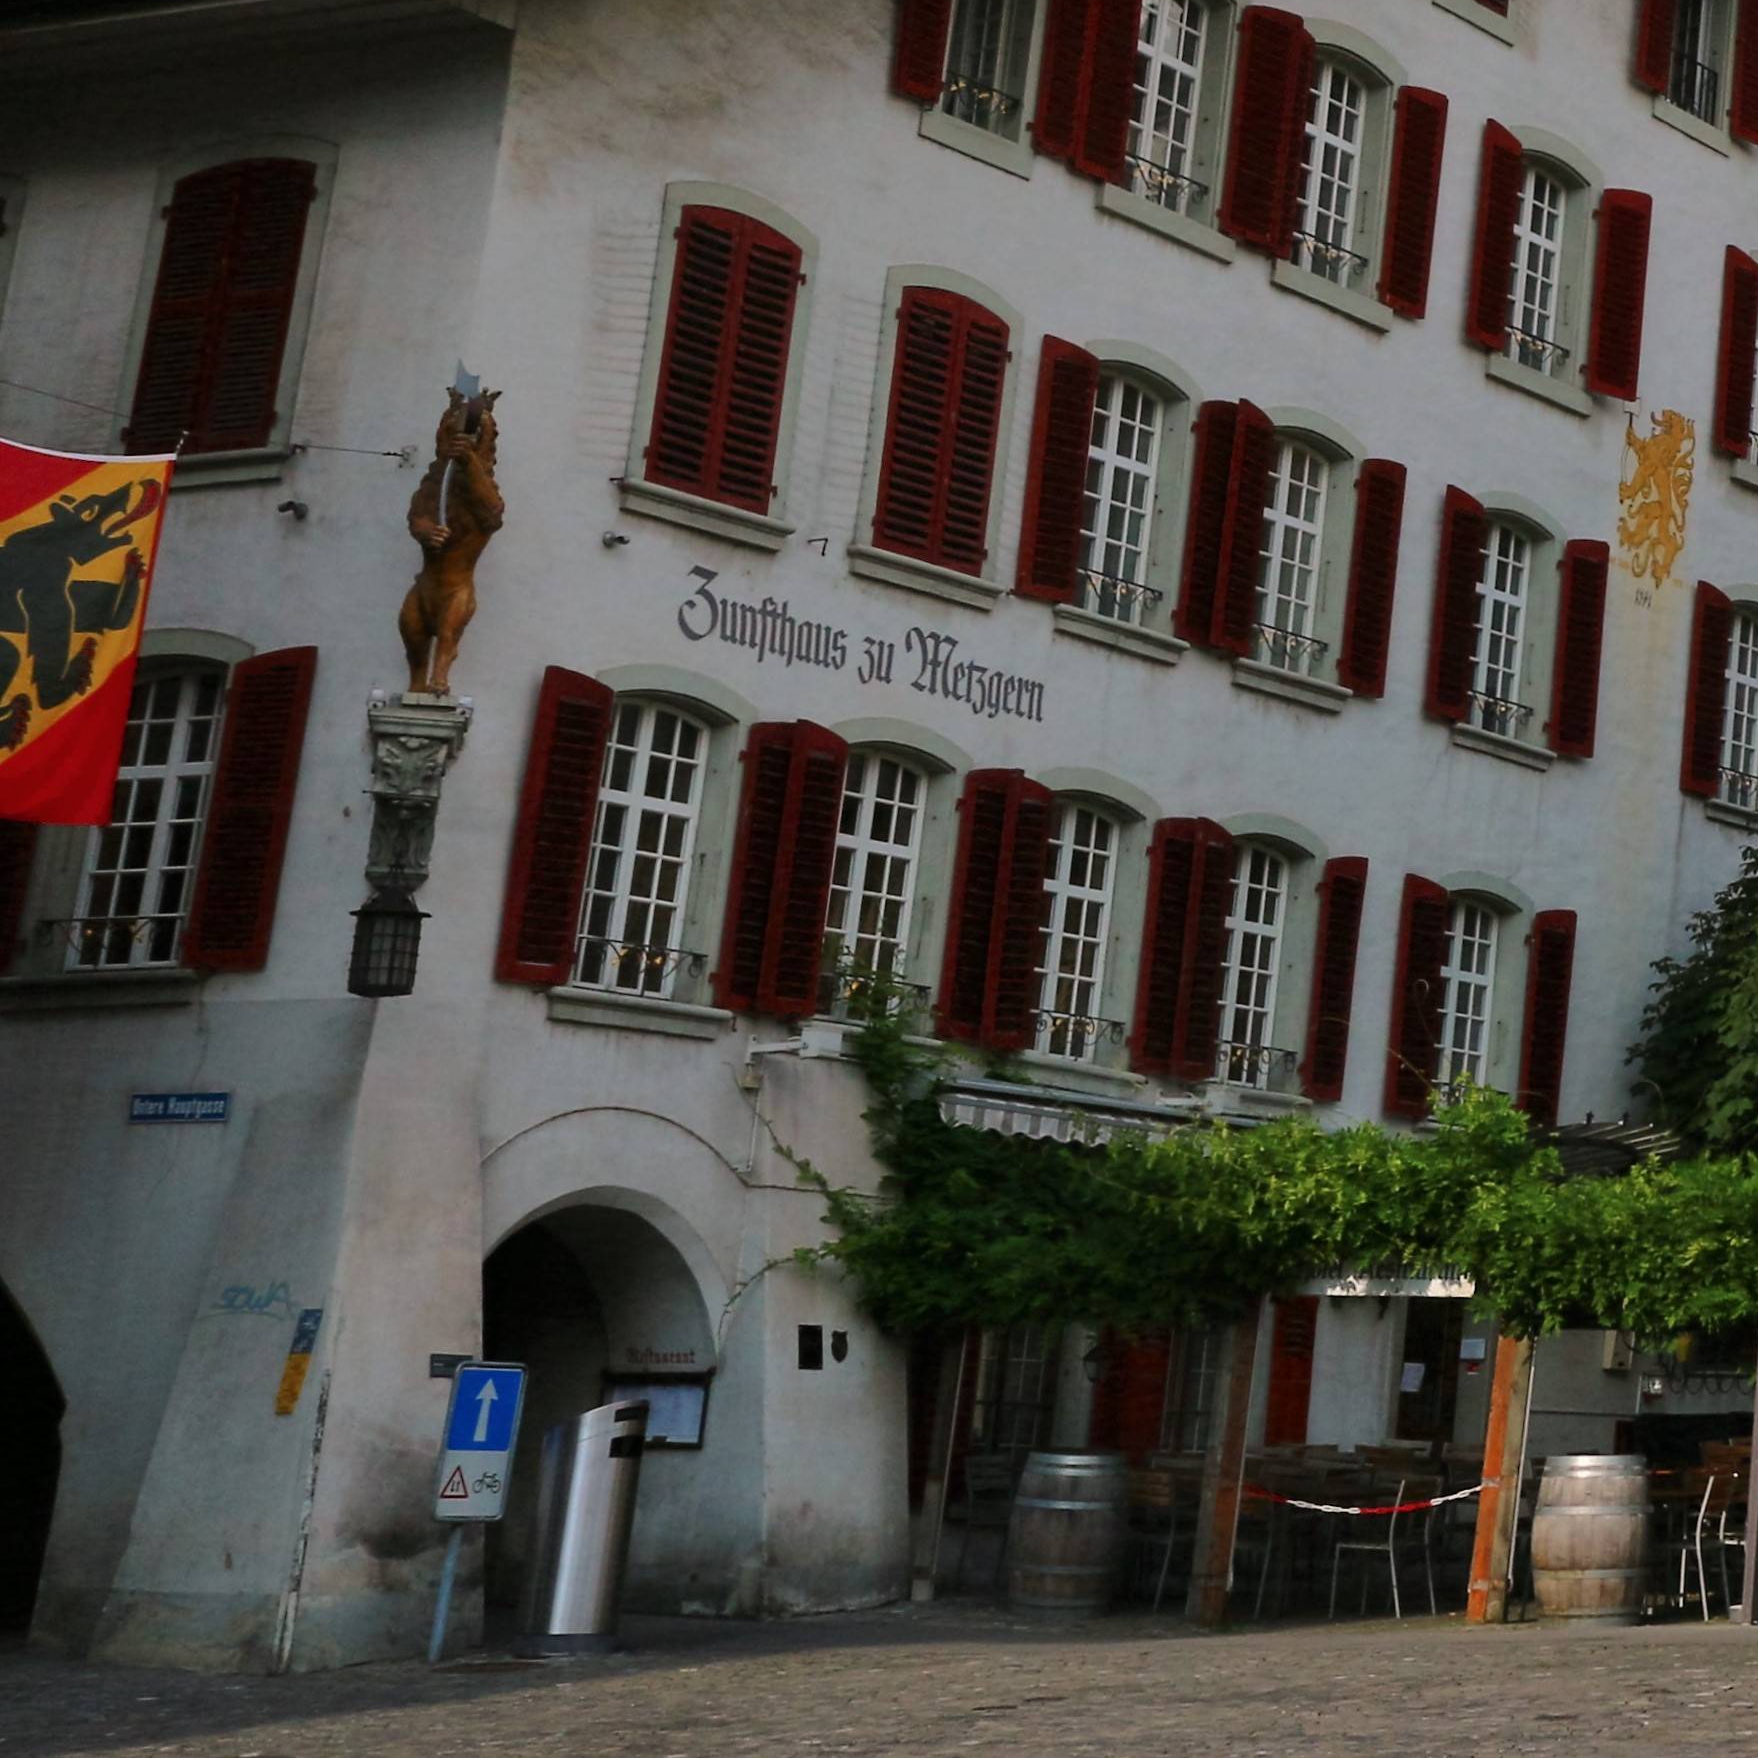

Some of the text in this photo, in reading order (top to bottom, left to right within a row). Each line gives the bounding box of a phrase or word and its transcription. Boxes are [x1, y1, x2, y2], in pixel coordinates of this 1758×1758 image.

[677, 564, 1045, 723] Zunfthaus zu Metzgern
